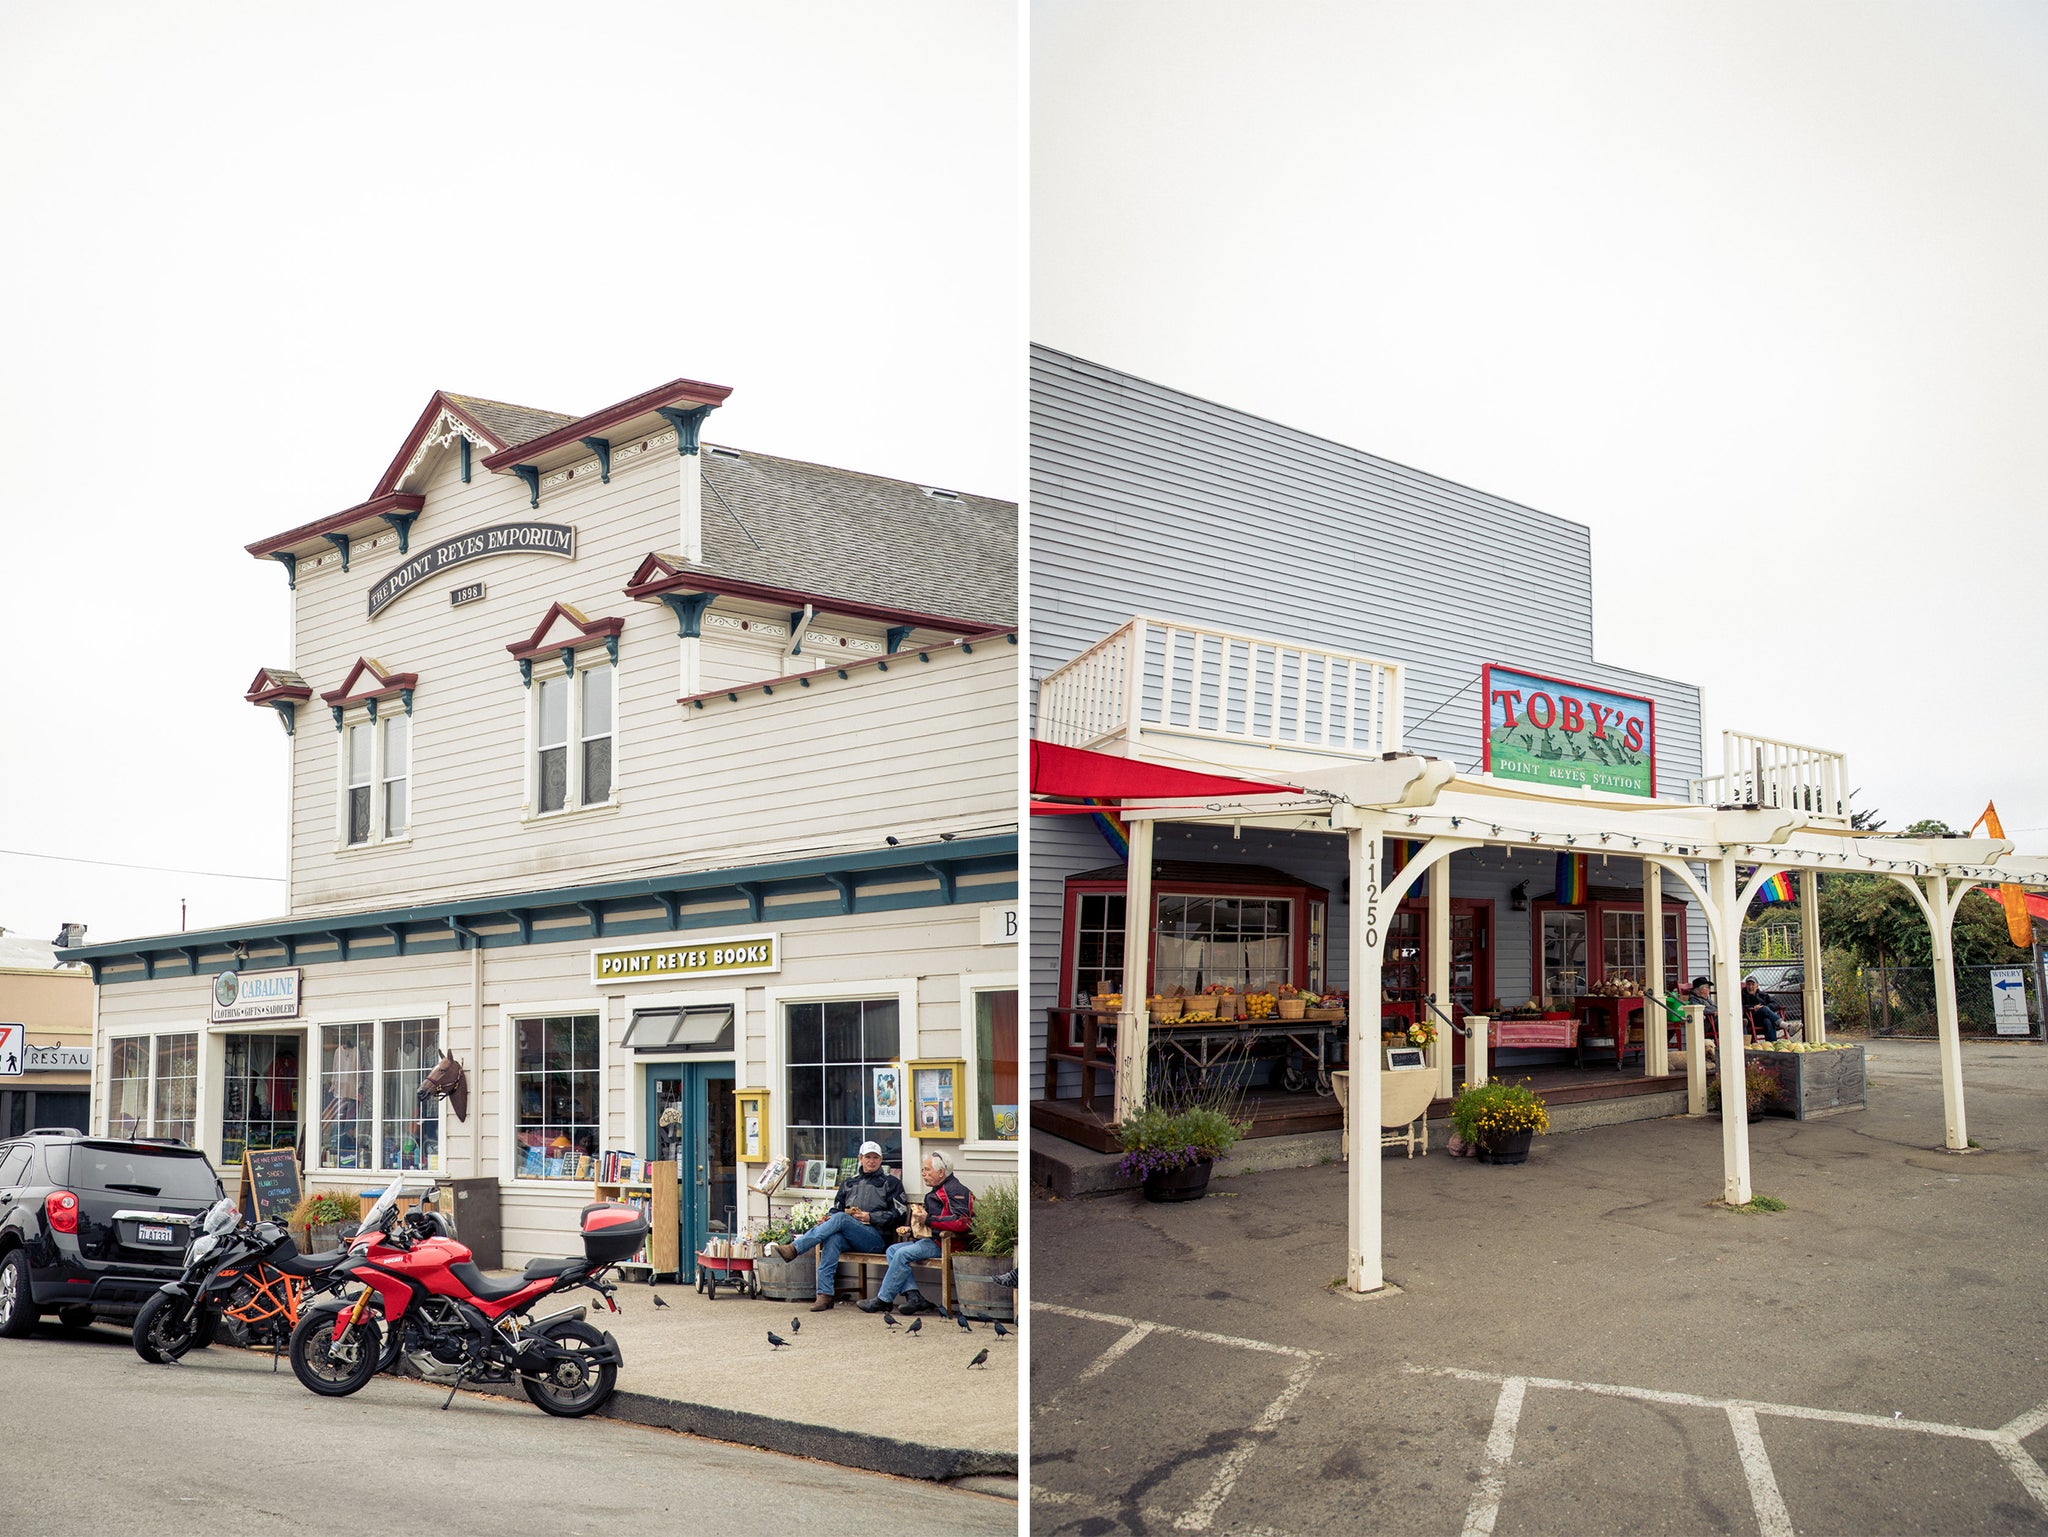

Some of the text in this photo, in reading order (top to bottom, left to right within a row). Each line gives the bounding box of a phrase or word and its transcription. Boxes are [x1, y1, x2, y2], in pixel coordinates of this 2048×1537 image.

[371, 527, 572, 607] THE POINT REYES EMPORIUM
[457, 586, 478, 602] 1898
[1492, 689, 1645, 752] TOBY'S
[1500, 759, 1641, 790] POINT REYES STATION
[1366, 840, 1378, 948] 11250
[602, 945, 768, 973] POINT REYES BOOKS
[241, 977, 294, 999] CABALINE
[214, 1003, 296, 1019] CLOTHING GIFTS SADDLERY
[31, 1053, 89, 1065] RESTAU
